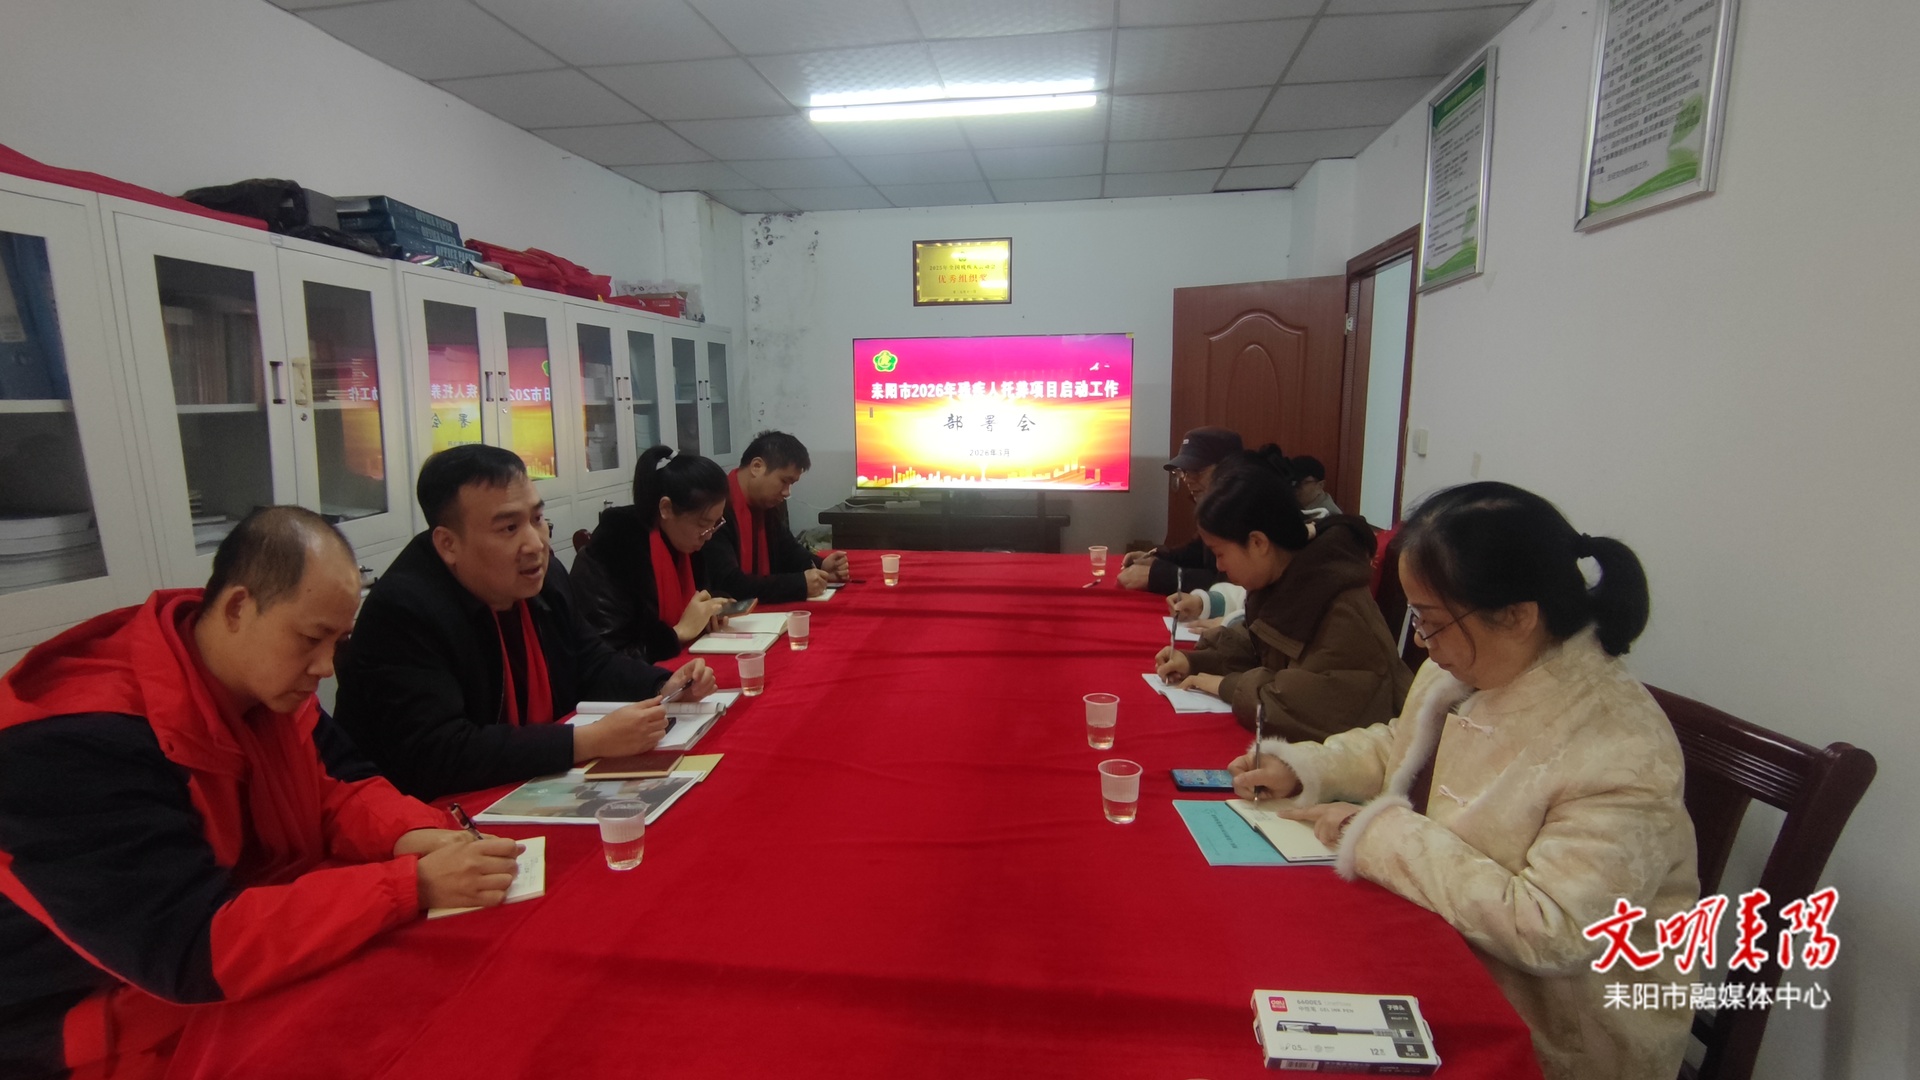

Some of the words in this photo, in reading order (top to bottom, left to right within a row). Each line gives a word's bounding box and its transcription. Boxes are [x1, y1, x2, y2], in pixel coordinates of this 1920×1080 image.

[415, 209, 436, 227] OFFICE
[435, 244, 458, 260] OFFICE
[938, 273, 988, 284] 优秀组织奖
[871, 380, 1119, 400] 耒阳市2026年残疾人托养项目启动工作
[943, 412, 1036, 433] 部署会
